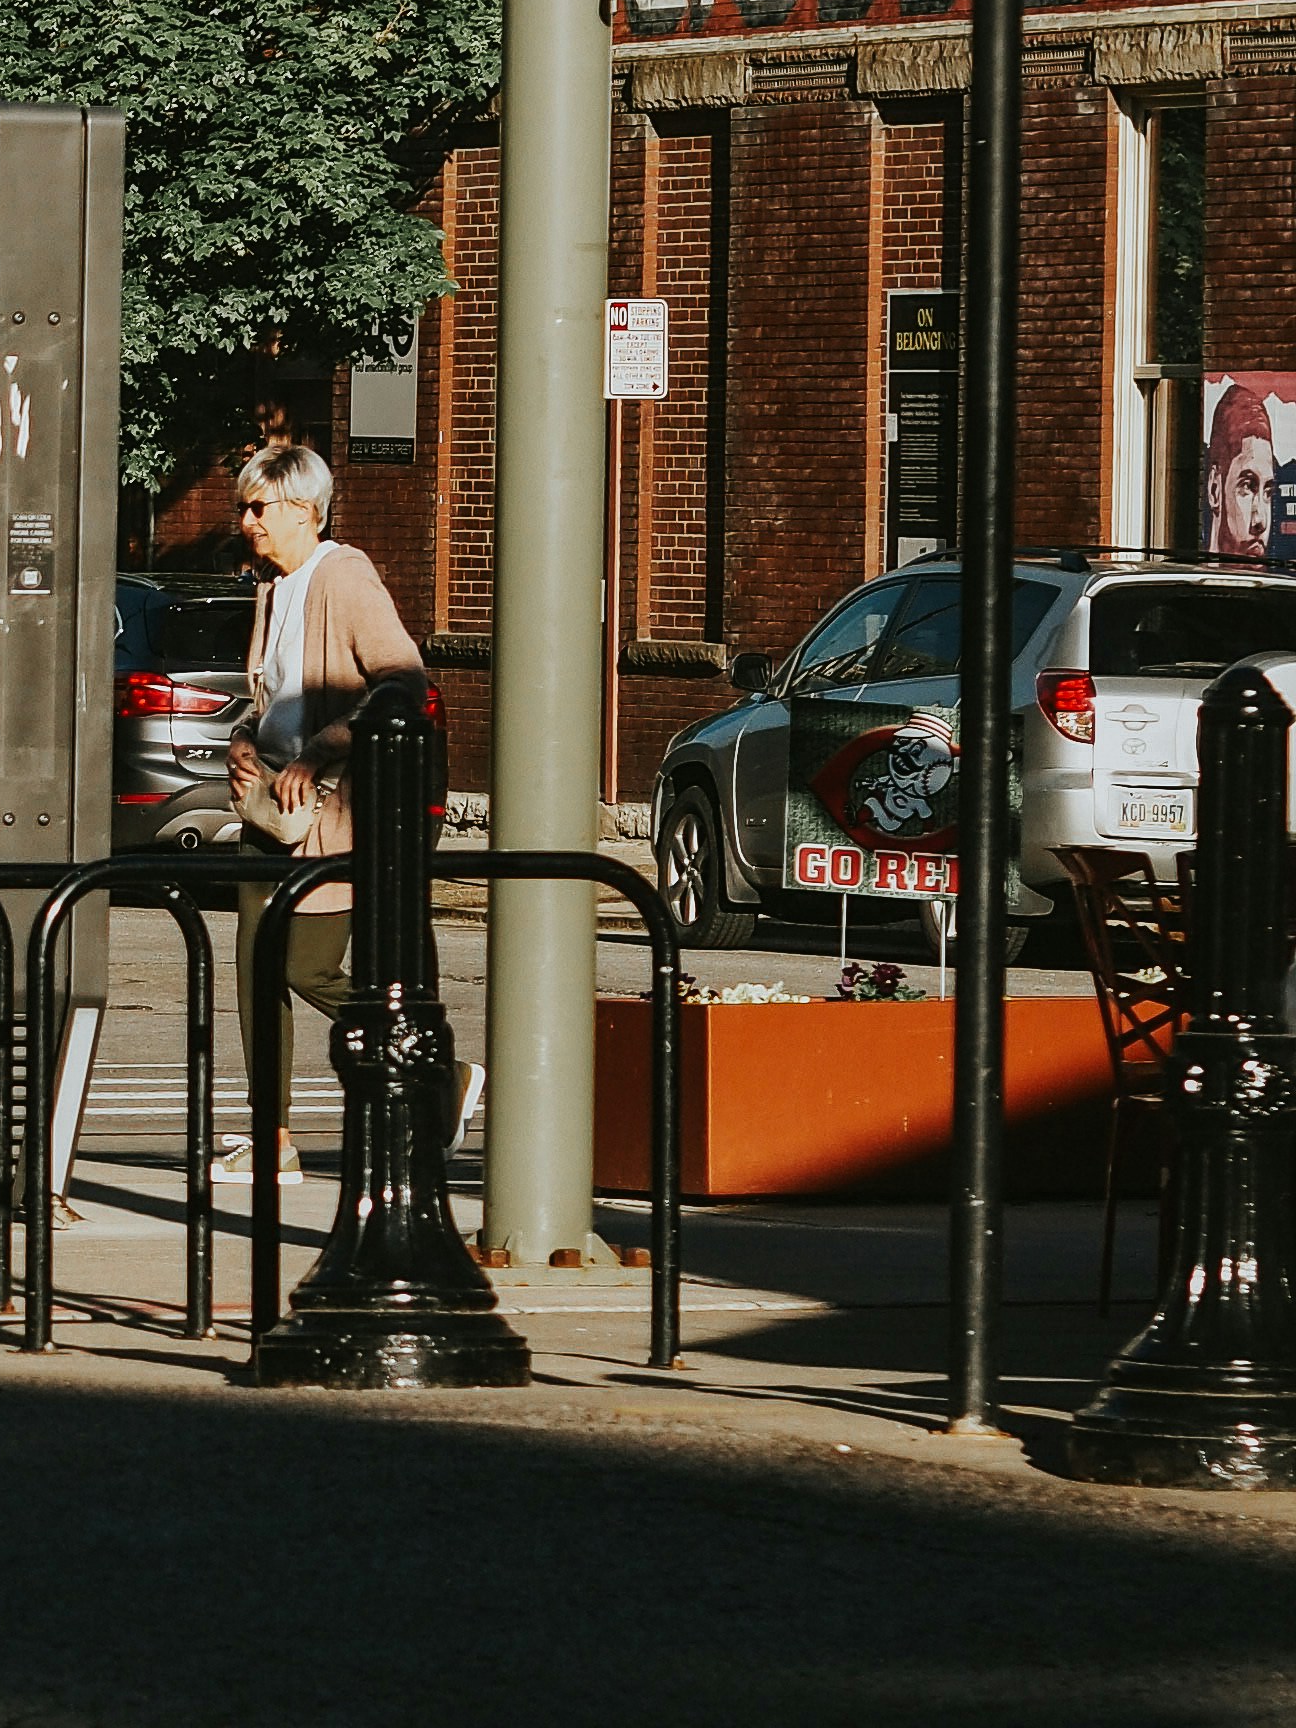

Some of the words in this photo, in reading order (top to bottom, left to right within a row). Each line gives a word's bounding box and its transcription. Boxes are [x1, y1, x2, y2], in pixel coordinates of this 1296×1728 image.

[611, 306, 627, 326] NO
[632, 318, 659, 328] PARKING
[917, 308, 933, 327] ON
[896, 331, 956, 351] BELONGING
[1121, 802, 1146, 822] KCD
[1152, 804, 1184, 824] 9957
[796, 843, 864, 888] GO
